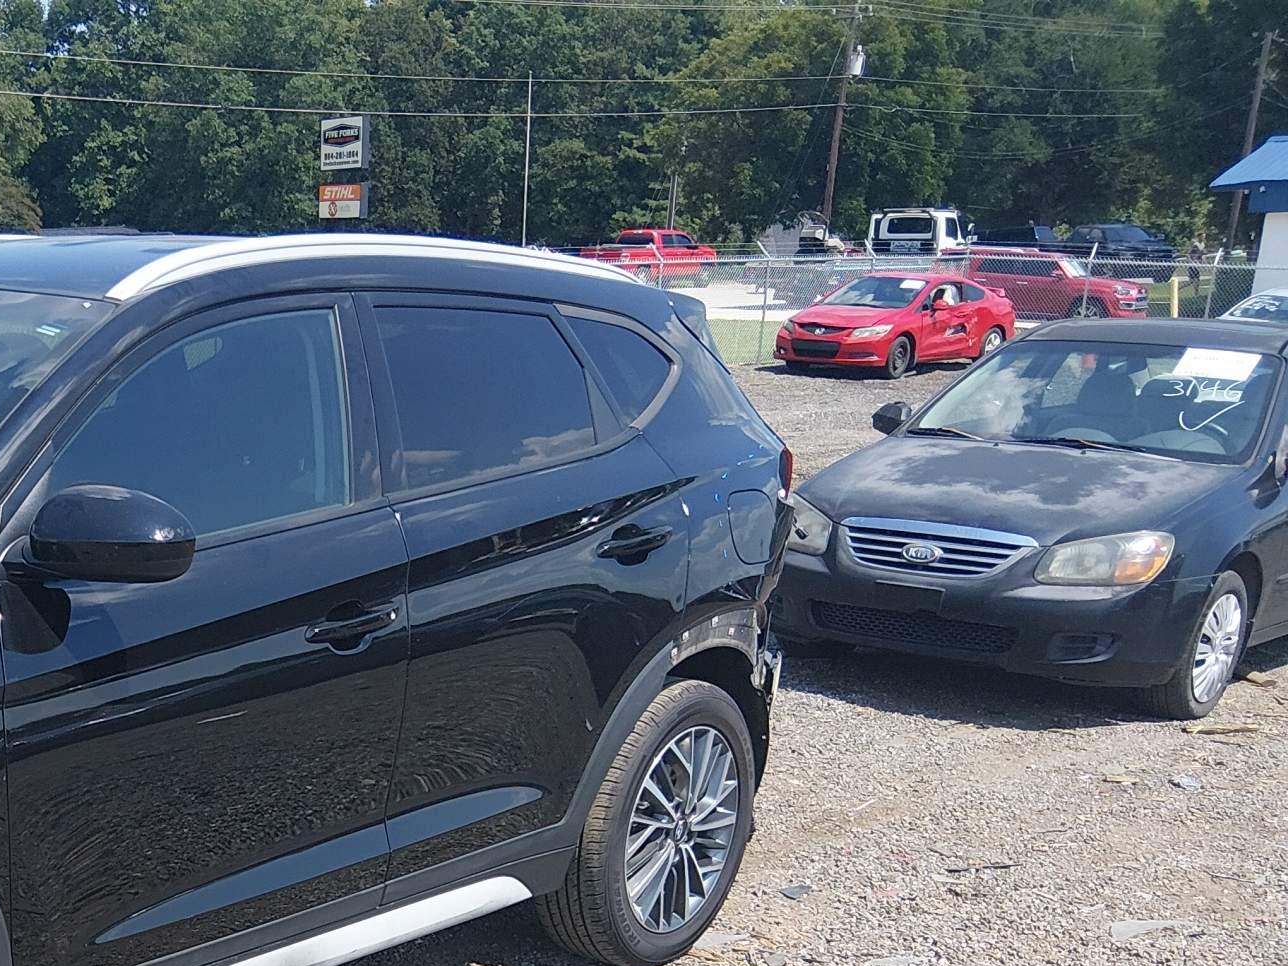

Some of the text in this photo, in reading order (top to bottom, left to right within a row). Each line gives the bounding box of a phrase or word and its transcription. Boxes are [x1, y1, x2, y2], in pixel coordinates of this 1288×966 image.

[325, 130, 339, 139] FIVE
[324, 186, 355, 199] STIHL
[908, 547, 931, 560] KIA
